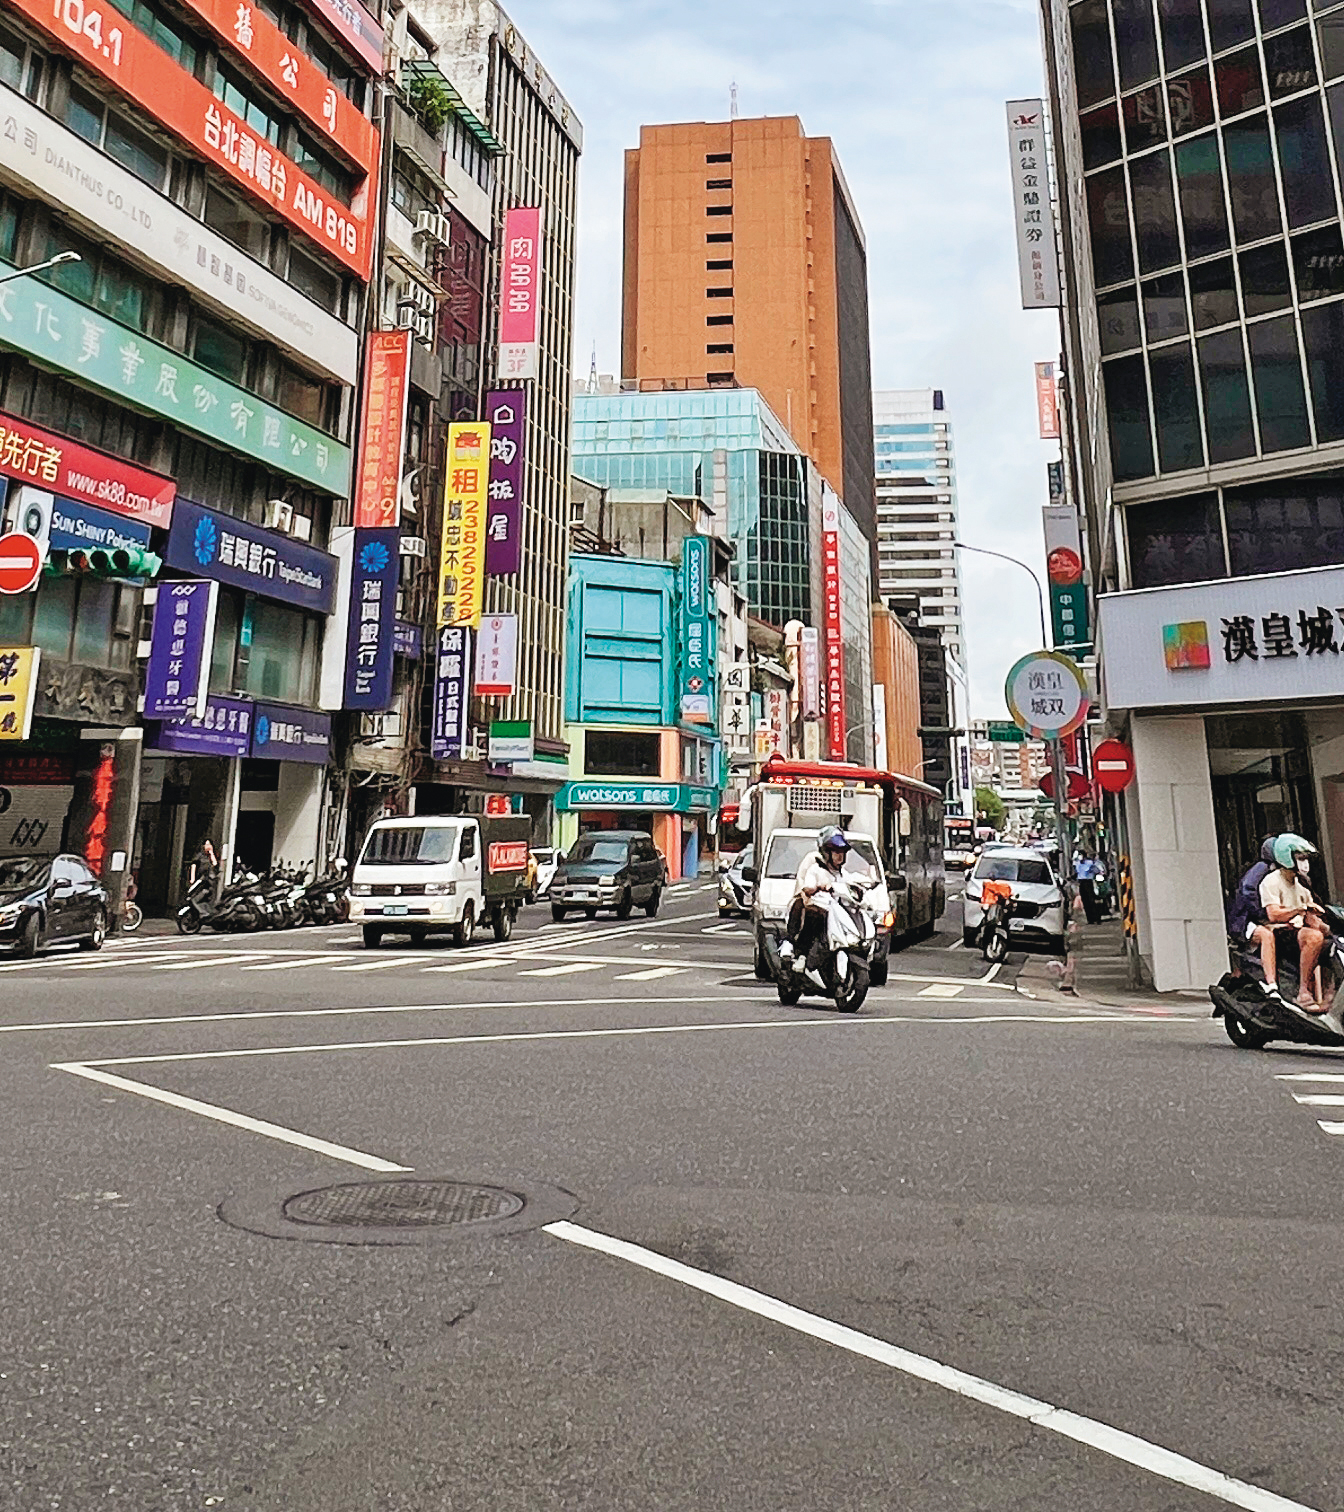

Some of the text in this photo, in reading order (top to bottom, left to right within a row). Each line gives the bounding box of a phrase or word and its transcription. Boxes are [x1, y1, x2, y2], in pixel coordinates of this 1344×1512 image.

[45, 146, 104, 198] DIANTHUS
[292, 182, 324, 230] AM
[325, 206, 357, 255] 819
[509, 237, 533, 313] 肉多多
[452, 468, 479, 493] 租
[489, 437, 517, 541] 陶板屋
[52, 511, 75, 534] SUN
[459, 500, 479, 620] 23825228
[690, 548, 701, 607] watsons
[577, 788, 637, 802] watsons
